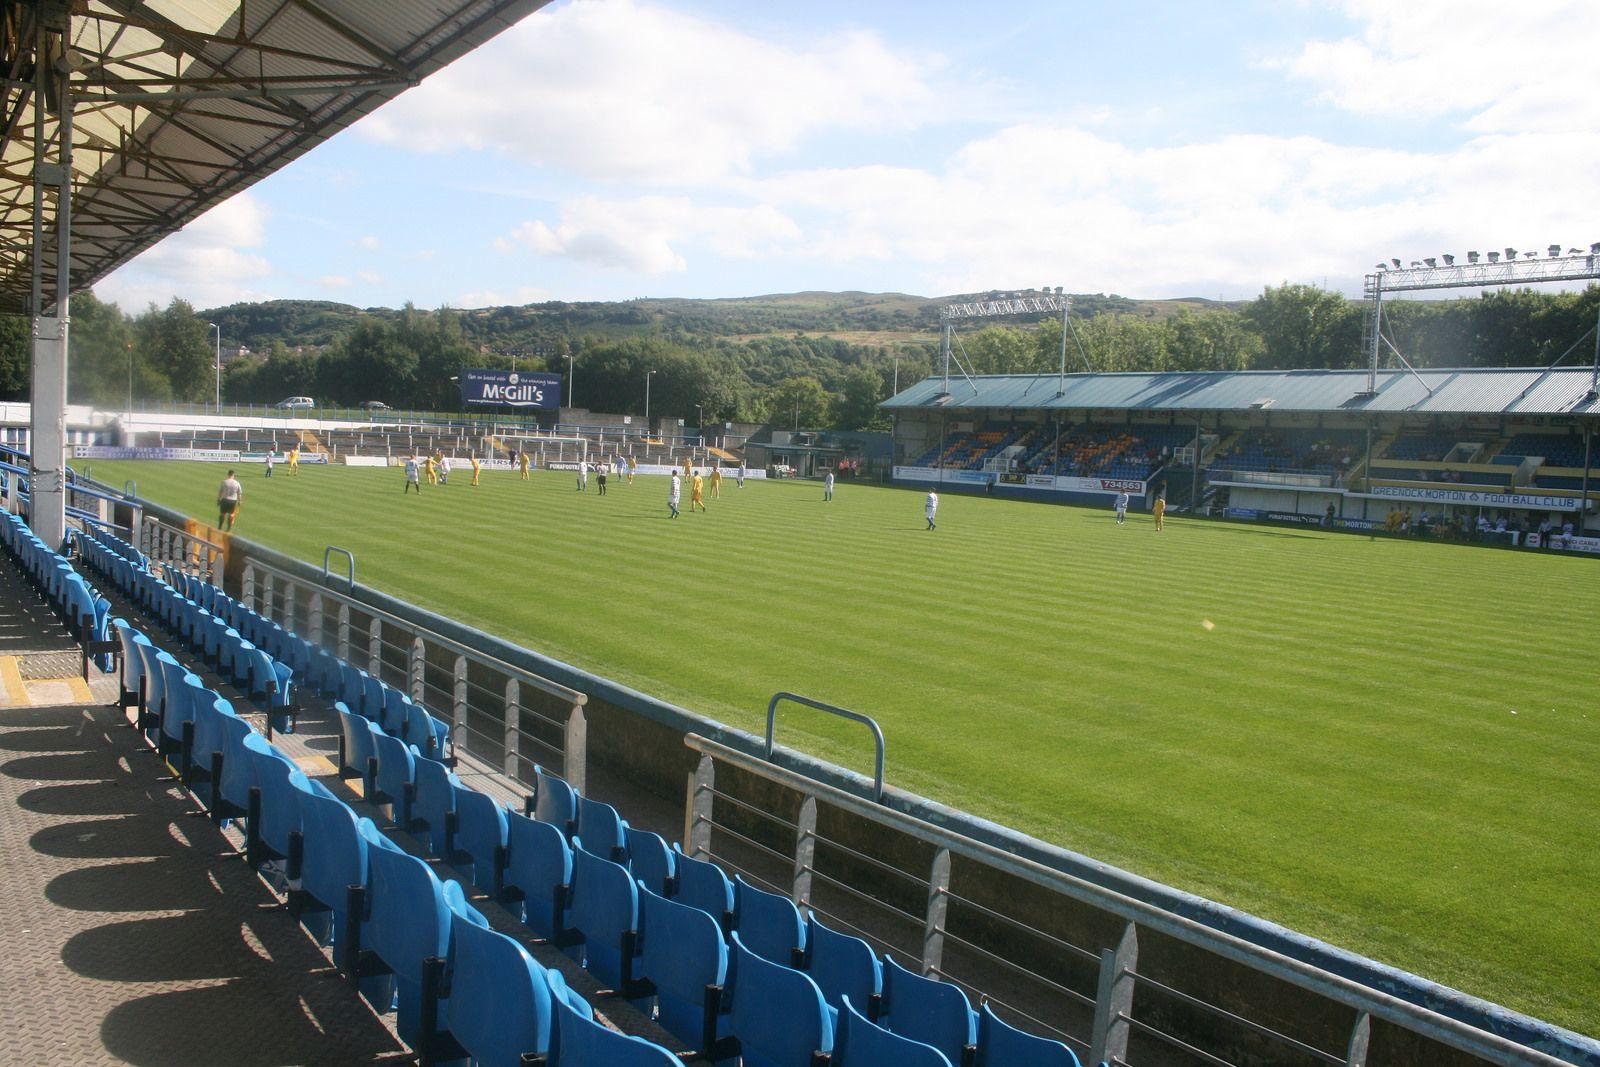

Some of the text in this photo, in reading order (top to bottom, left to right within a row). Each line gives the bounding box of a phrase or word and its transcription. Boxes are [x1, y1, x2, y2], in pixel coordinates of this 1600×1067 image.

[482, 383, 543, 402] McGill's
[1372, 487, 1575, 508] GREENOCK MORTON FOOTBALL CLUB
